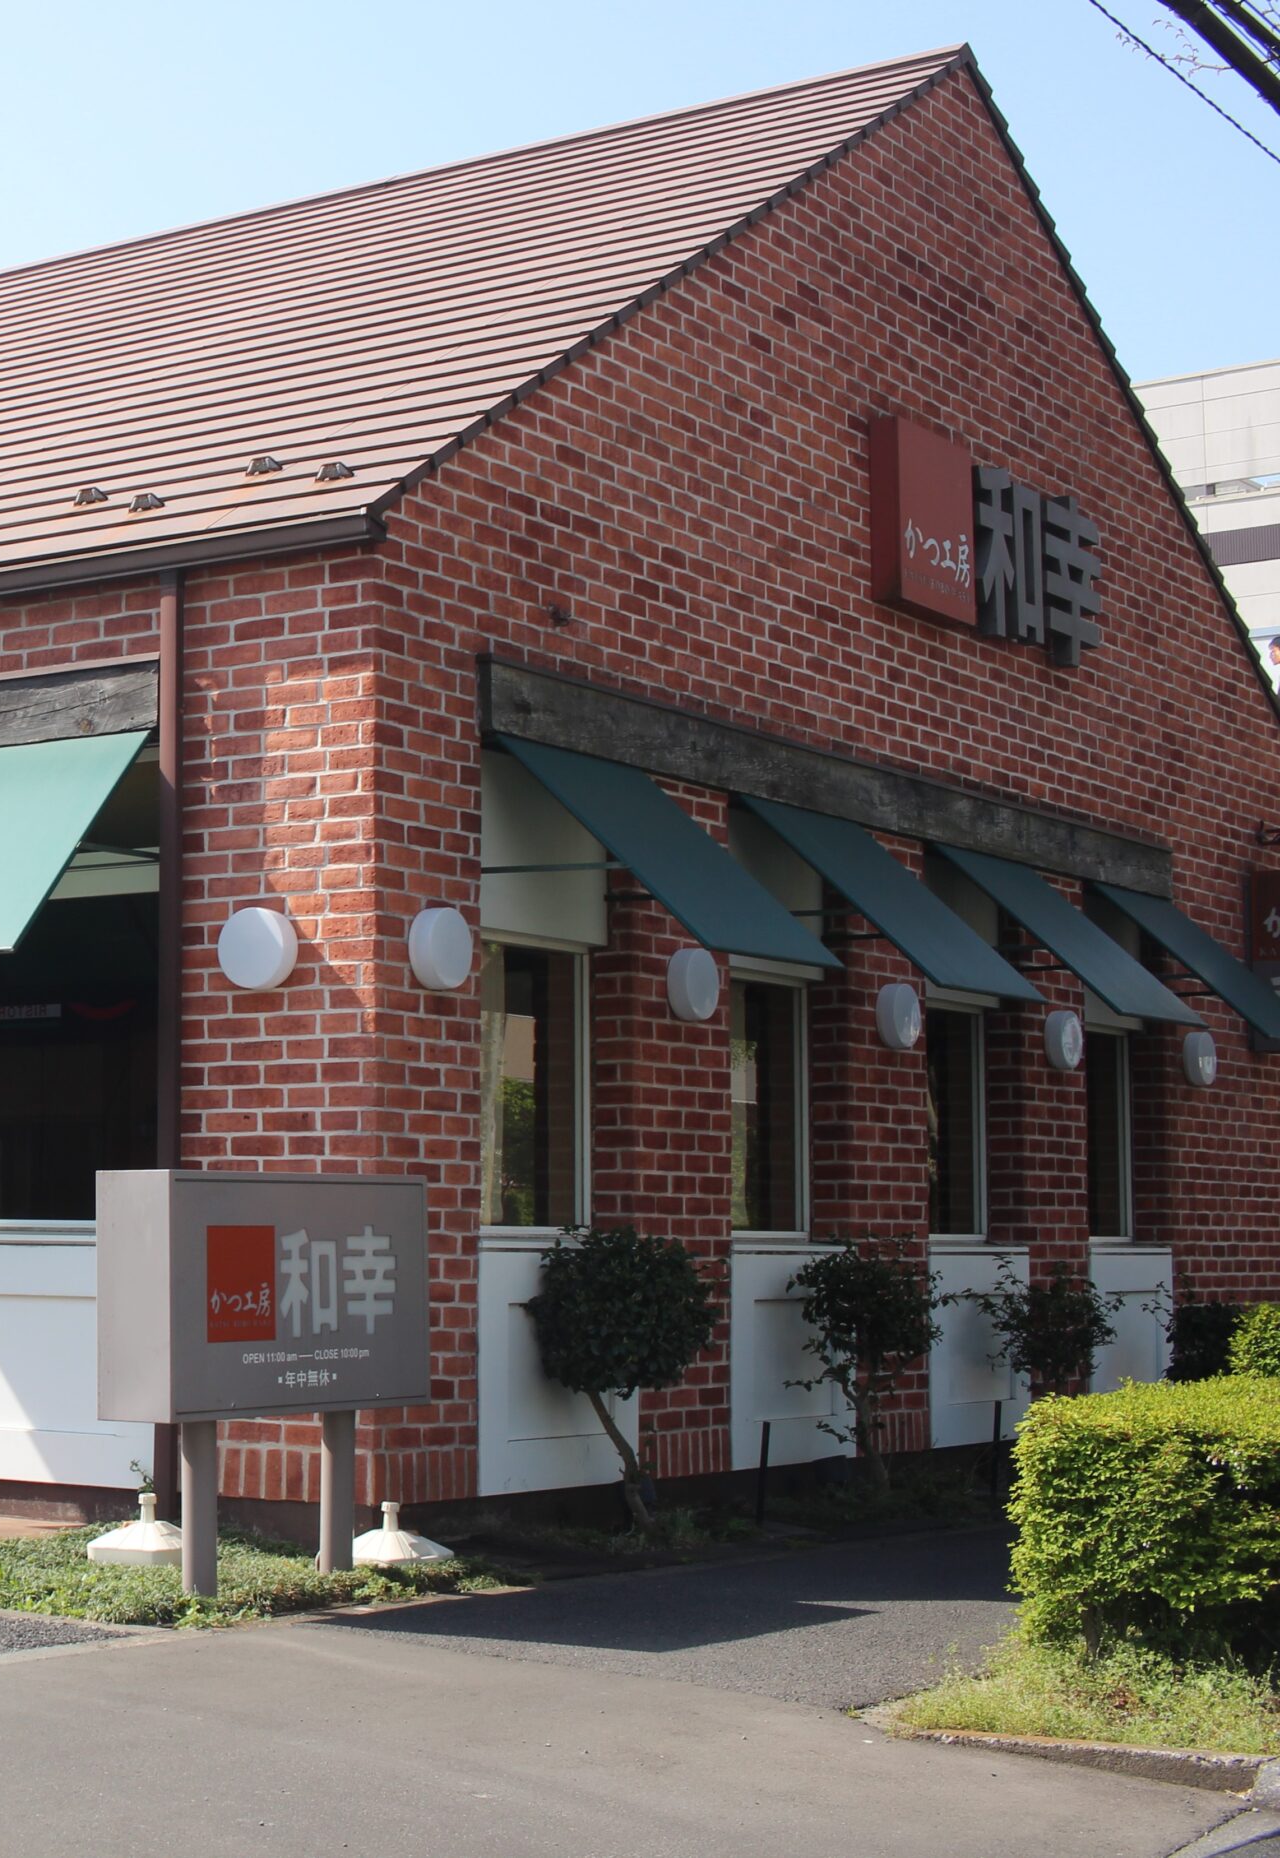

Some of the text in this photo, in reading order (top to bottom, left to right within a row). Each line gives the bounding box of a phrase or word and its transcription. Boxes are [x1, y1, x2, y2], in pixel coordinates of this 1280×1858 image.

[904, 518, 970, 588] かつ工房
[973, 464, 1102, 668] 和幸
[210, 1282, 271, 1317] かつ工房
[279, 1225, 397, 1338] 和幸
[242, 1353, 265, 1364] OPEN
[266, 1352, 286, 1363] 11:00
[286, 1353, 298, 1362] am
[314, 1349, 339, 1360] CLOSE
[340, 1348, 358, 1359] 10:00
[285, 1369, 330, 1388] 年中無休
